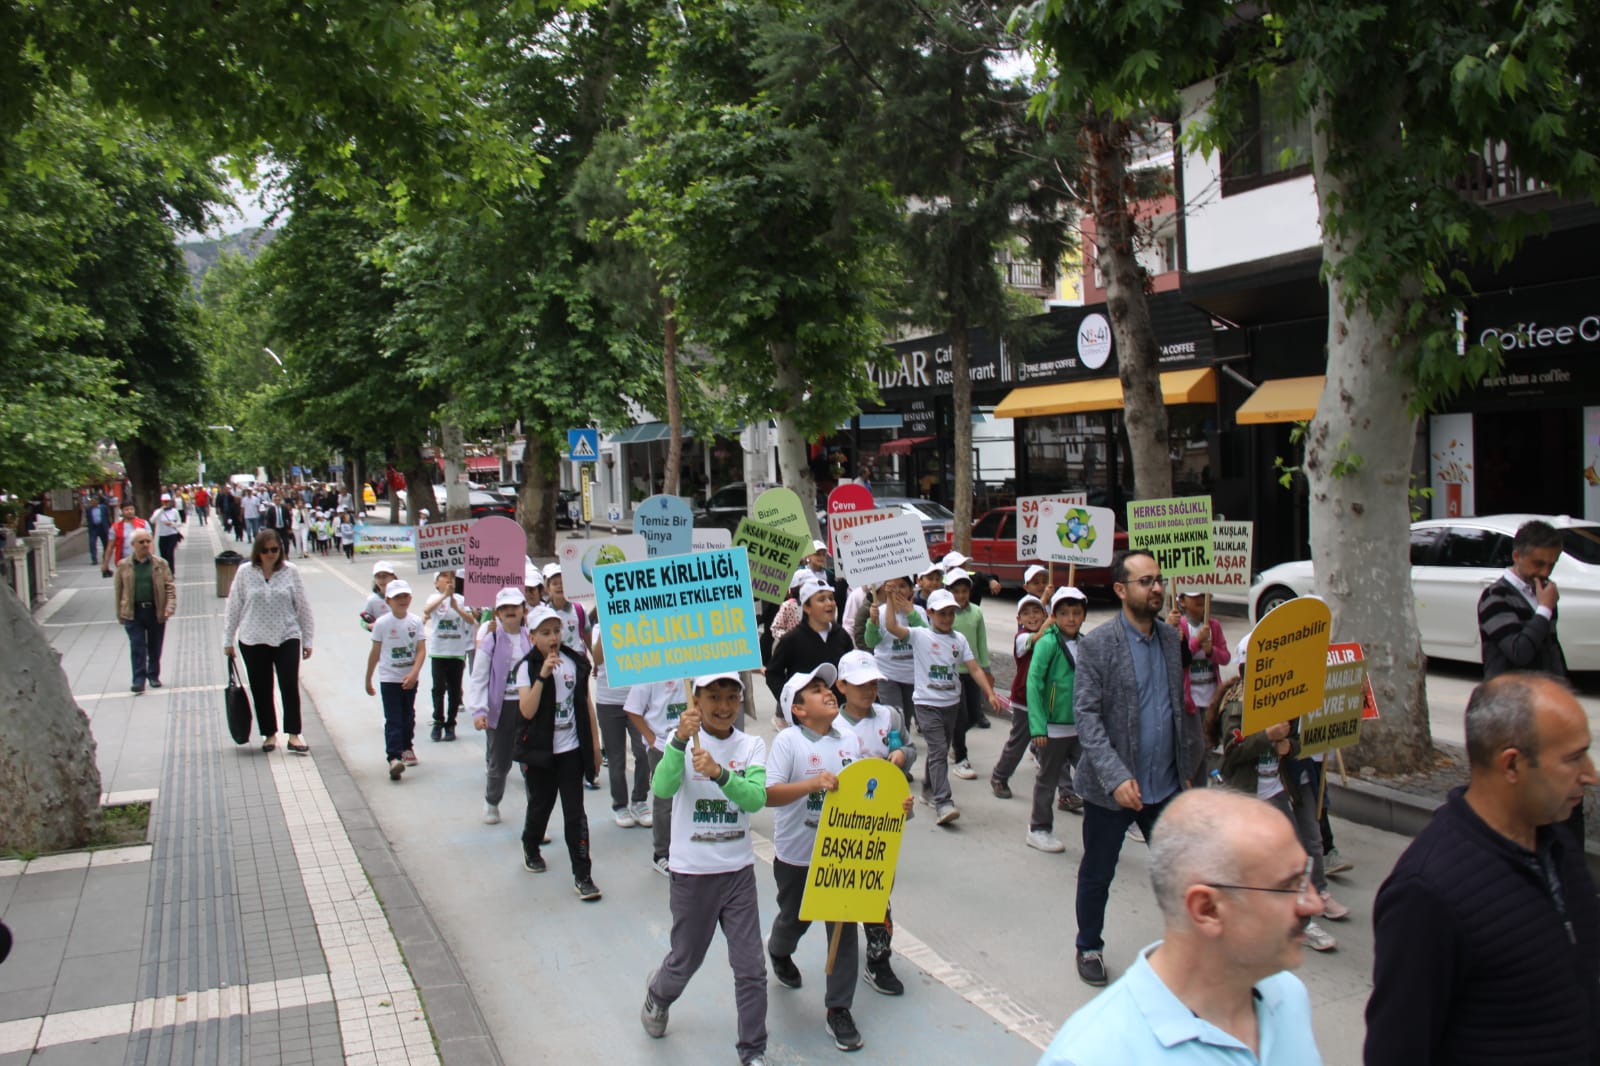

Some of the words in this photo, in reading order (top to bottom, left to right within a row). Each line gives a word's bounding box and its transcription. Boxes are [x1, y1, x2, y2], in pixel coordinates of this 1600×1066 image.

[1480, 322, 1574, 352] Coffee
[1168, 342, 1196, 355] COFFEE
[1054, 358, 1076, 369] COFFEE
[757, 507, 779, 520] Bizim
[832, 500, 856, 511] Çevre
[1133, 503, 1167, 518] HERKES
[1168, 500, 1208, 516] SAĞLIKLI,
[639, 515, 670, 527] Temiz
[672, 515, 688, 527] Bir
[418, 523, 469, 539] LÜTFEN
[640, 531, 672, 543] Dünya
[1134, 533, 1171, 547] YAŞAMAK
[1173, 529, 1208, 544] HAKKINA
[1219, 525, 1249, 538] KUŞLAR,
[469, 536, 480, 550] Su
[768, 532, 800, 552] YAŞATAN
[1021, 549, 1037, 558] ÇEV
[421, 558, 449, 570] LAZIM
[451, 556, 466, 567] OL
[469, 555, 500, 570] Hayattır
[1213, 555, 1247, 570] AŞAR
[468, 573, 526, 588] Kirletmeyelim.
[604, 567, 657, 599] ÇEVRE
[660, 552, 740, 587] KİRLİLİĞİ,
[1175, 572, 1247, 586] NSANLAR.
[751, 577, 781, 598] NDIR.
[607, 599, 631, 616] HER
[634, 593, 678, 612] ANIMIZI
[680, 582, 744, 607] ETKİLEYEN
[610, 611, 706, 650] SAĞLIKLI
[709, 601, 747, 638] BİR
[1257, 620, 1327, 653] Yaşanabilir
[615, 649, 662, 673] YAŞAM
[664, 637, 753, 666] KONUSUDUR.
[1255, 656, 1275, 673] Bir
[1253, 669, 1294, 693] Dünya
[1252, 683, 1309, 711] İstiyoruz.
[1303, 725, 1327, 747] MARKA
[828, 805, 904, 836] Unutmayalım!
[821, 836, 864, 865] BAŞKA
[865, 837, 887, 862] BİR
[814, 863, 857, 889] DÜNYA
[860, 870, 885, 891] YOK.
